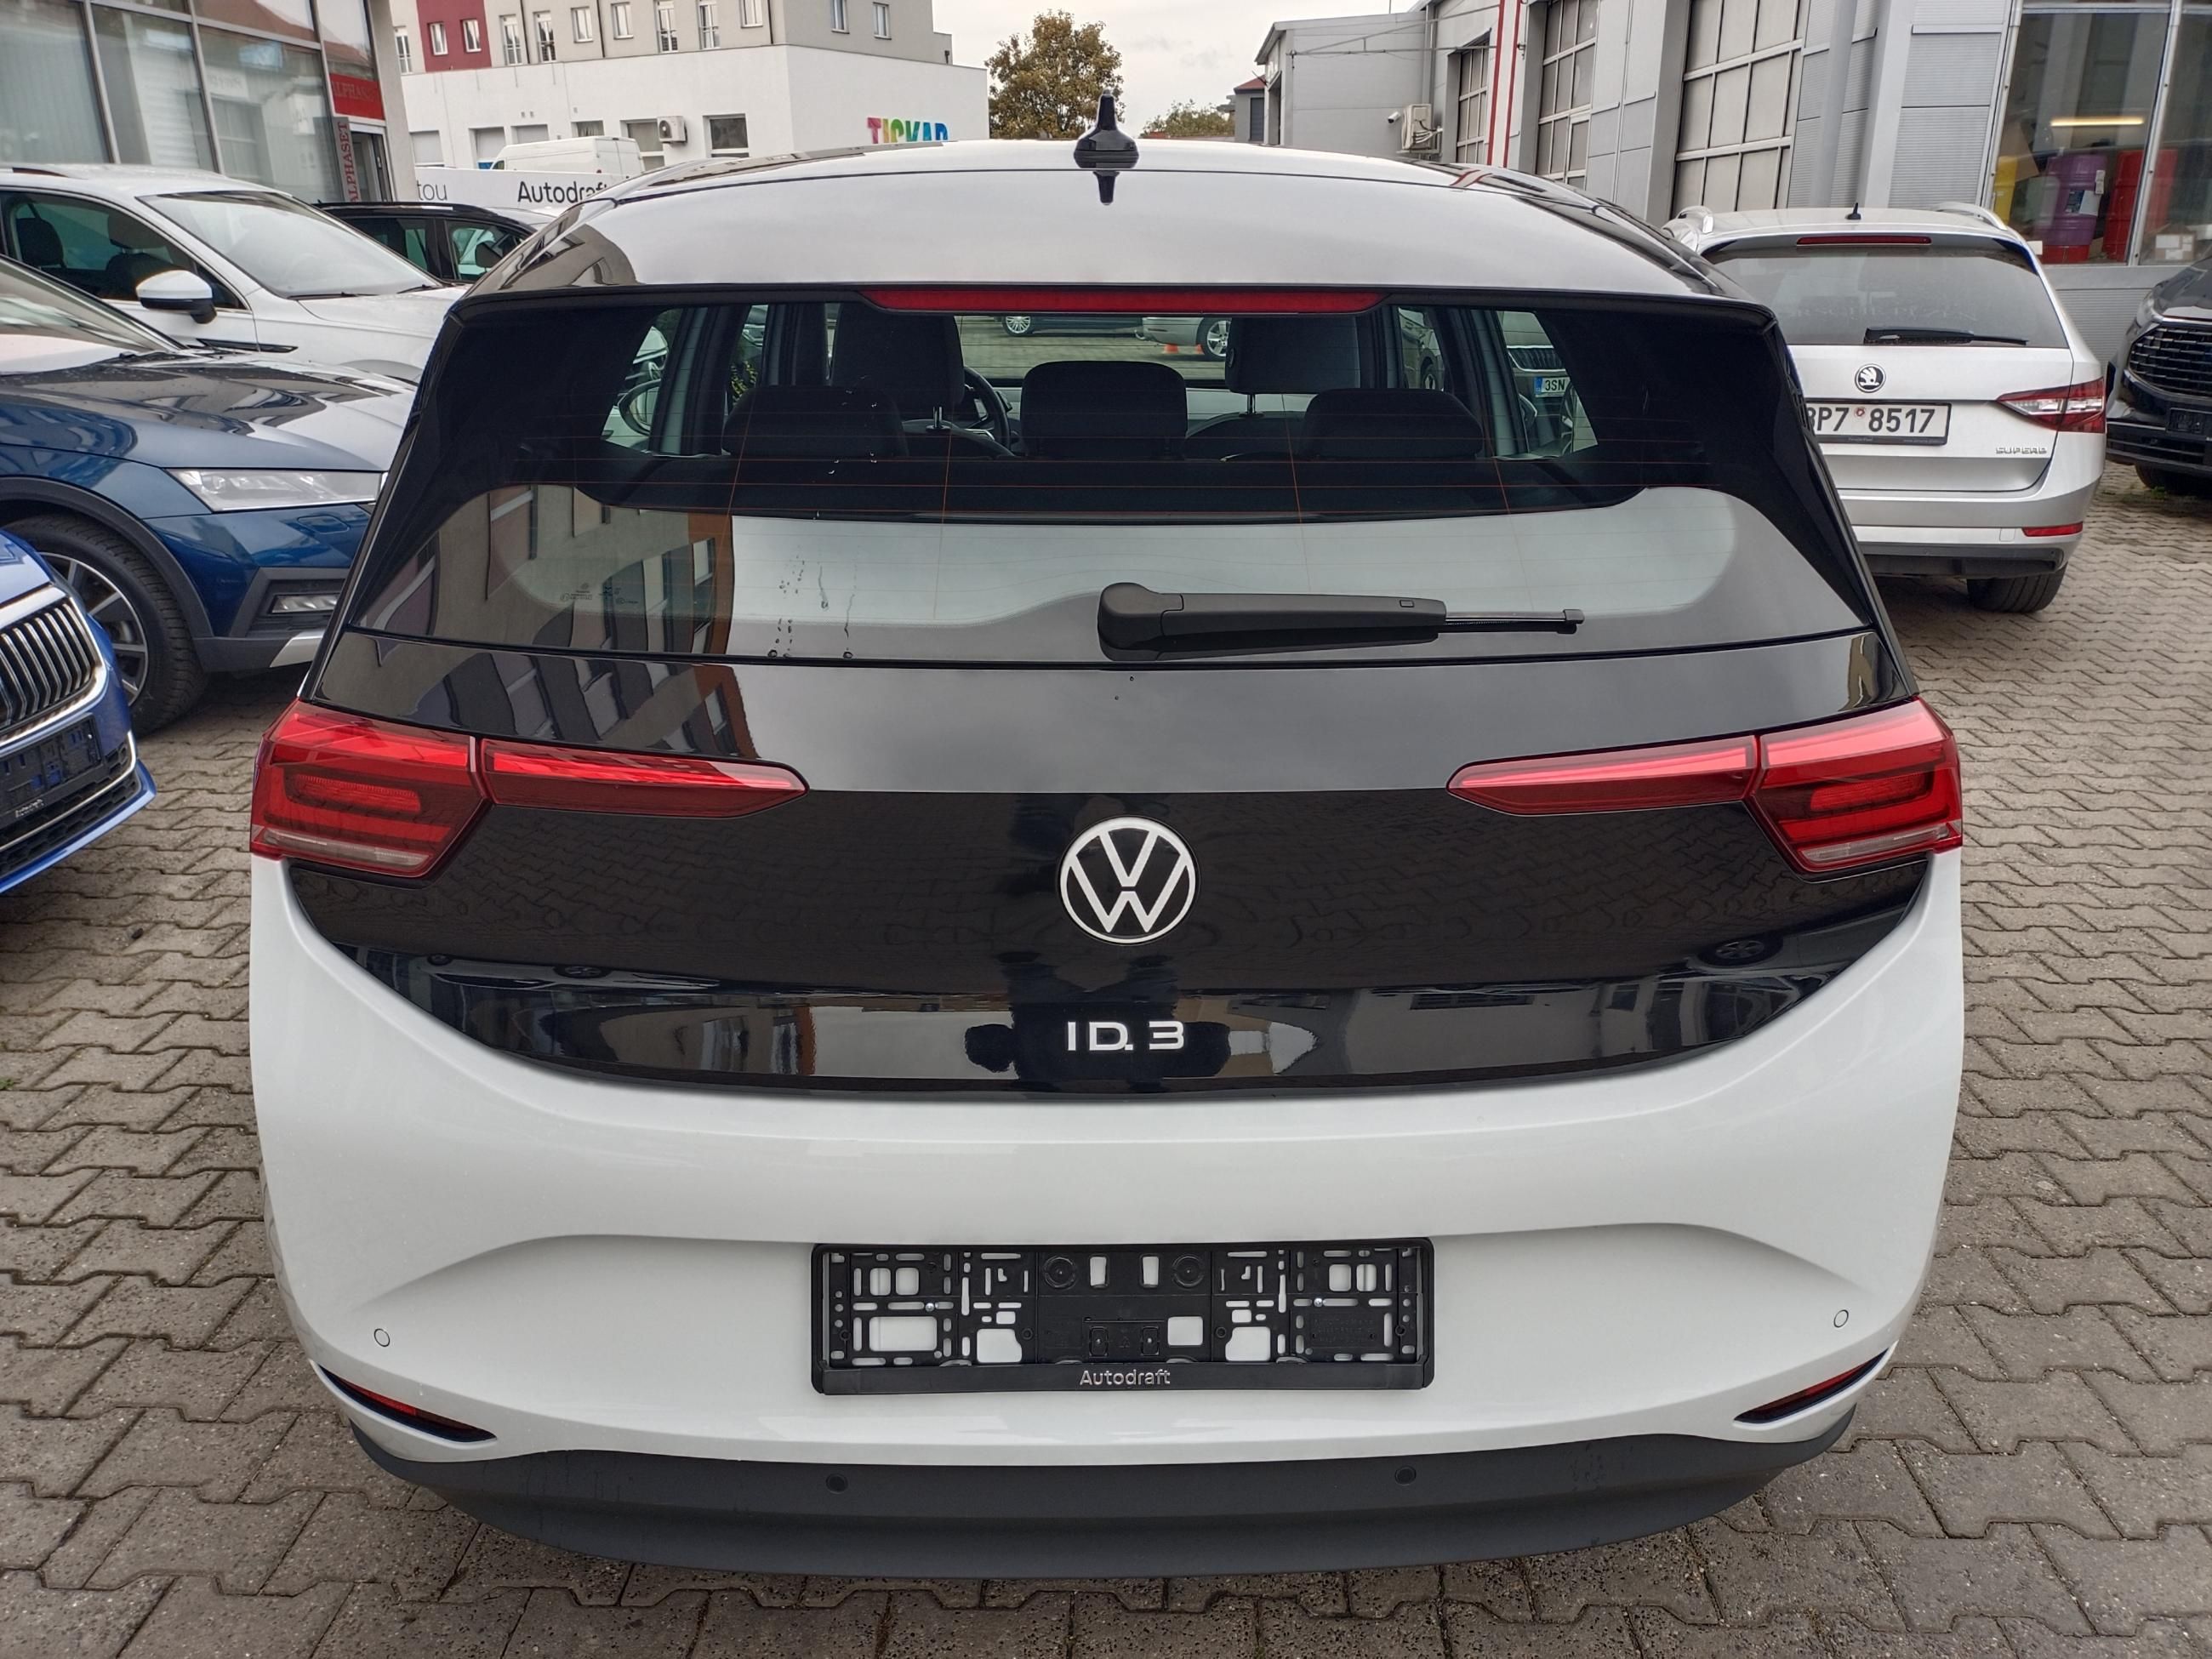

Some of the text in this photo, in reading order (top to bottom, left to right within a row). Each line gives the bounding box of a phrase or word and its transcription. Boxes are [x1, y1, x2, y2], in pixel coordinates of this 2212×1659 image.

[1545, 379, 1565, 391] 3SN
[1868, 408, 1936, 433] 8517
[1079, 1368, 1171, 1386] Autodraft
